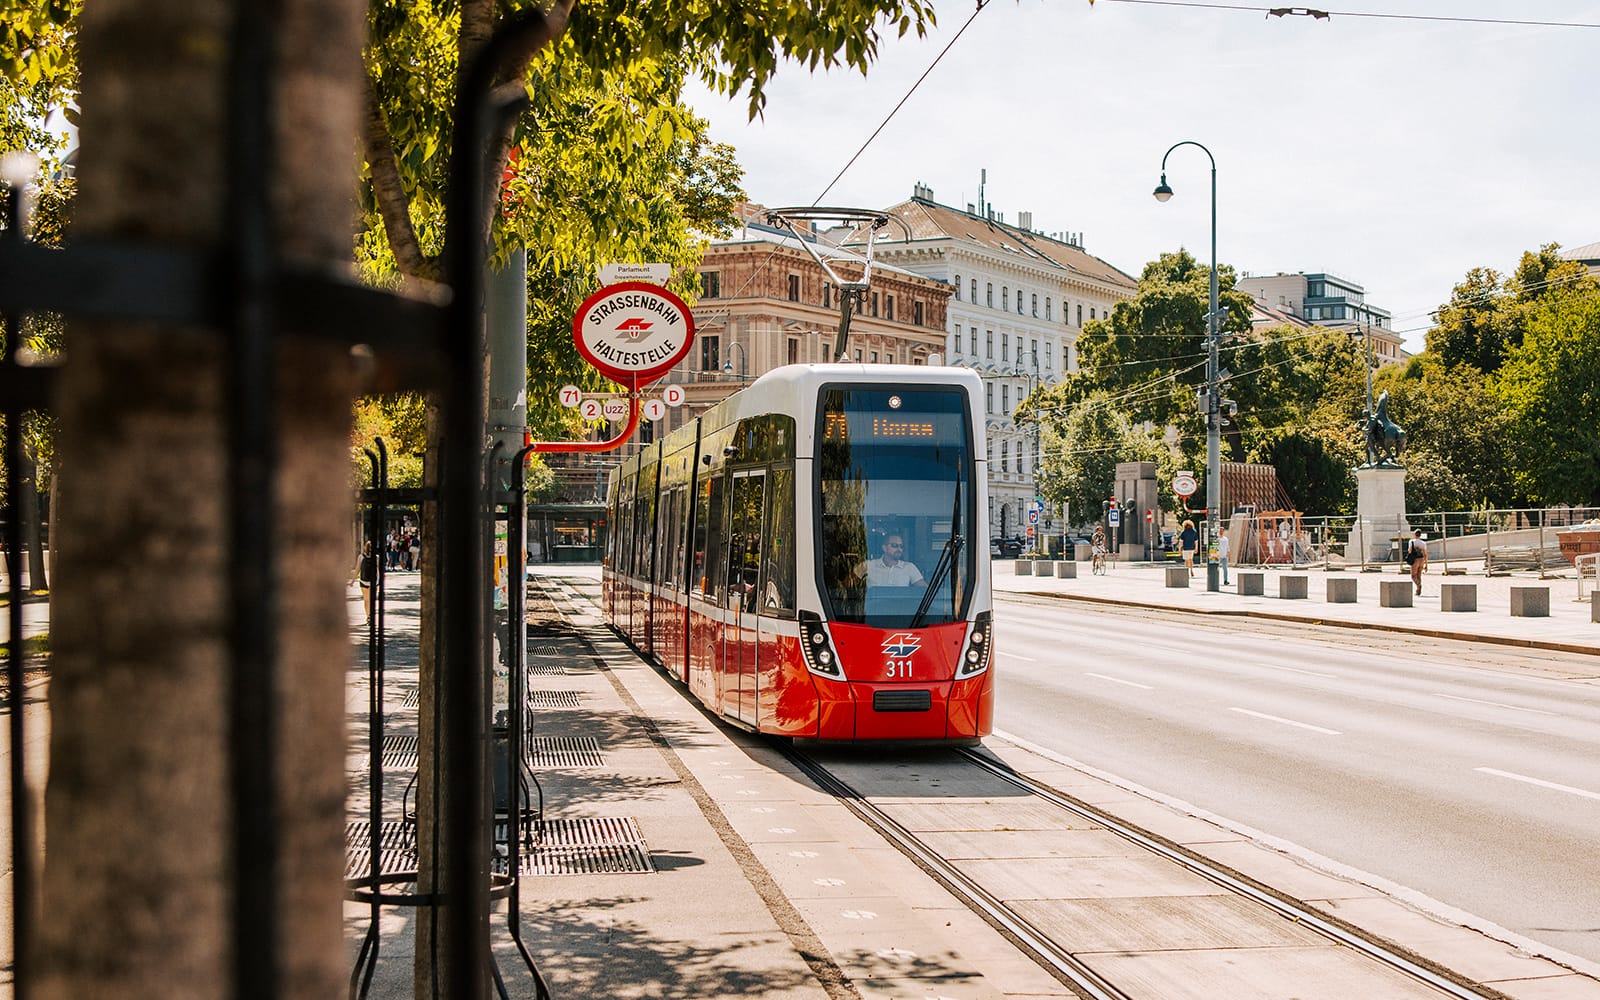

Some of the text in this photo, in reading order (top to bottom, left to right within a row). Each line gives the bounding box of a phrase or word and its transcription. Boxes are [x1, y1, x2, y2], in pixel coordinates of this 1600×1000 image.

[589, 295, 680, 326] STRASSENBAHN
[592, 339, 677, 366] HALTESTELLE
[563, 390, 579, 403] 71
[669, 390, 680, 402] D
[586, 403, 596, 417] 2
[605, 406, 624, 414] U2Z
[651, 404, 658, 416] 1
[825, 414, 846, 439] 71
[886, 660, 913, 678] 311
